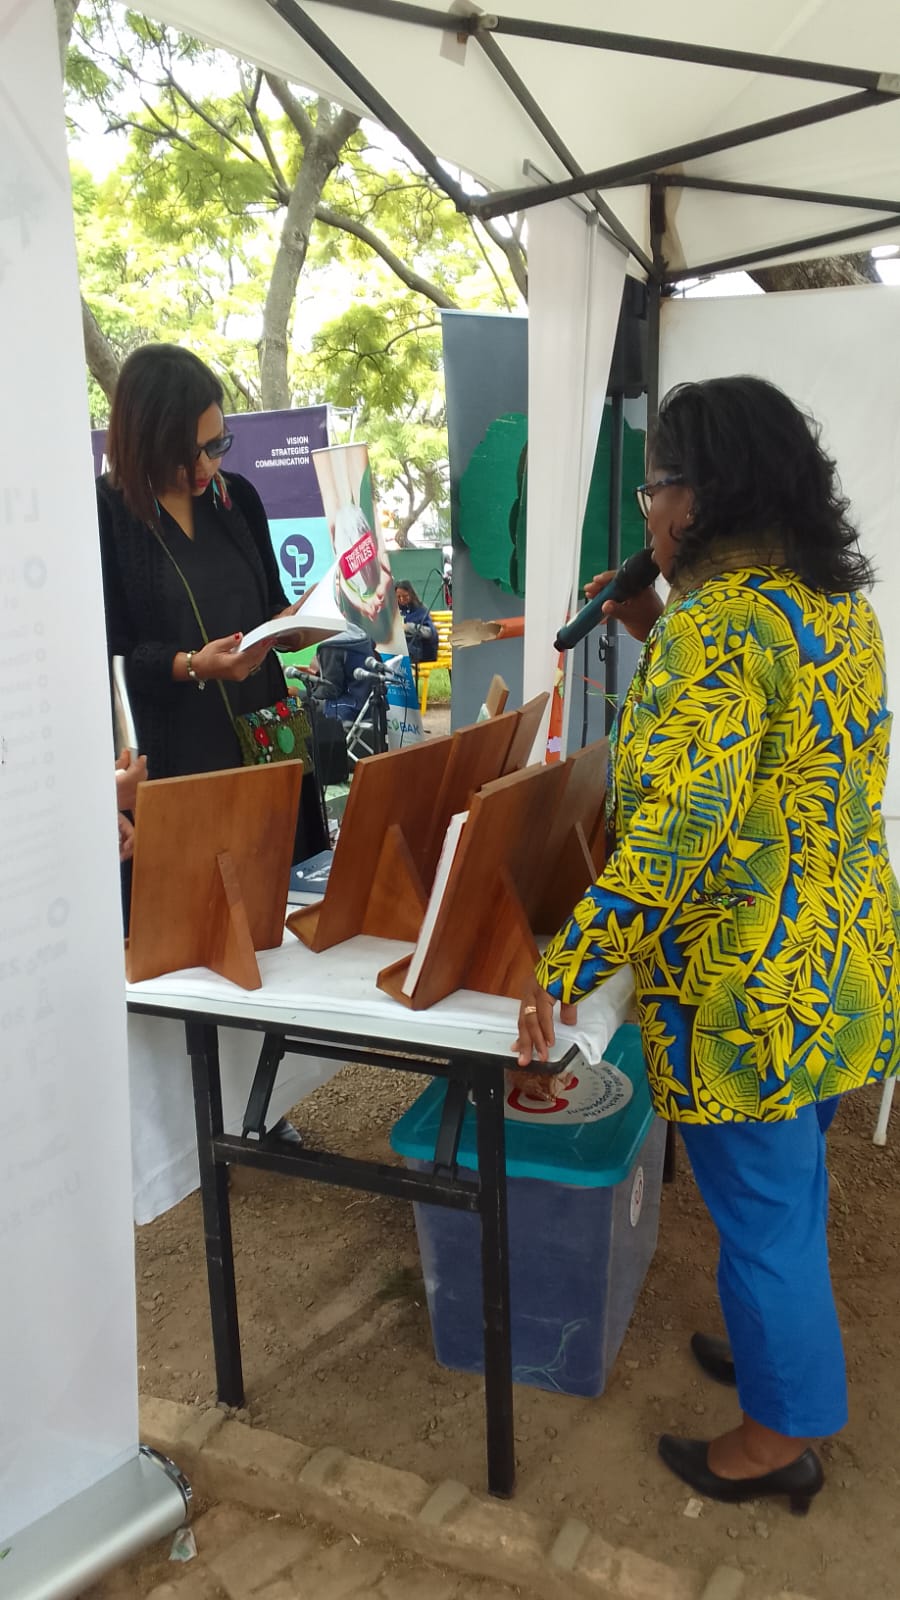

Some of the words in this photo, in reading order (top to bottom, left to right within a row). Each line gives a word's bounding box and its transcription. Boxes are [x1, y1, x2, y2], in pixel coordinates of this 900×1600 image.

[286, 436, 309, 445] VISION
[271, 446, 310, 457] STRATEGIES
[255, 456, 310, 468] COMMUNICATION
